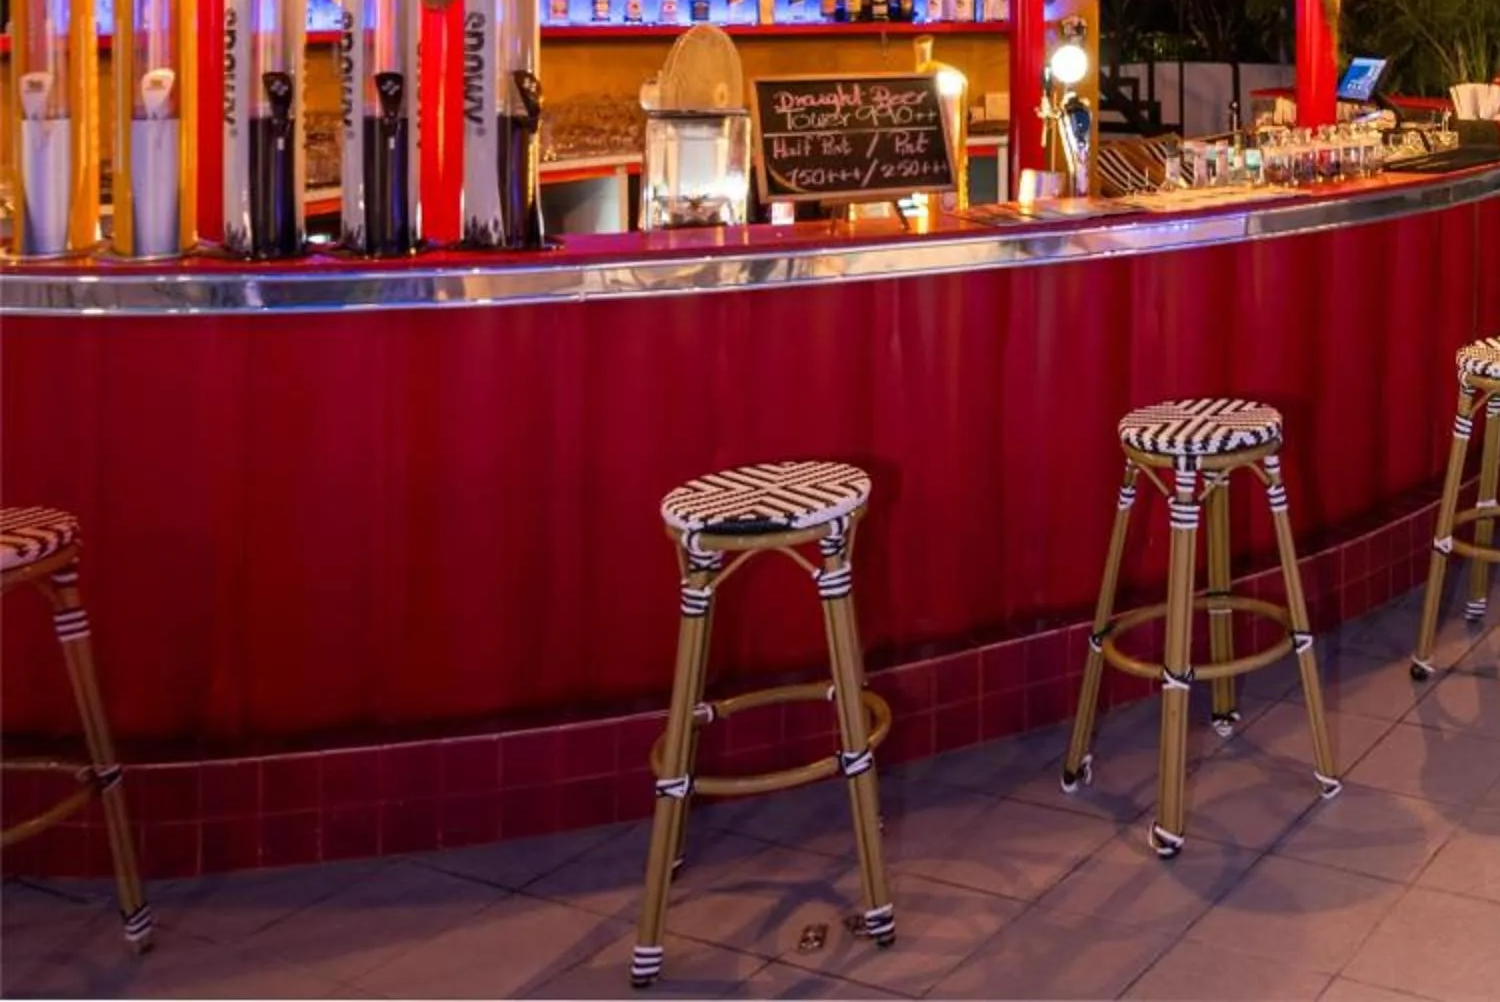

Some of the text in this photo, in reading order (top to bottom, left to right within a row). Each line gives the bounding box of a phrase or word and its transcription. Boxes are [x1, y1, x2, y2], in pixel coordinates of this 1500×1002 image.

[773, 83, 928, 115] Draught Beer
[774, 106, 850, 130] Tower
[773, 134, 812, 158] Half
